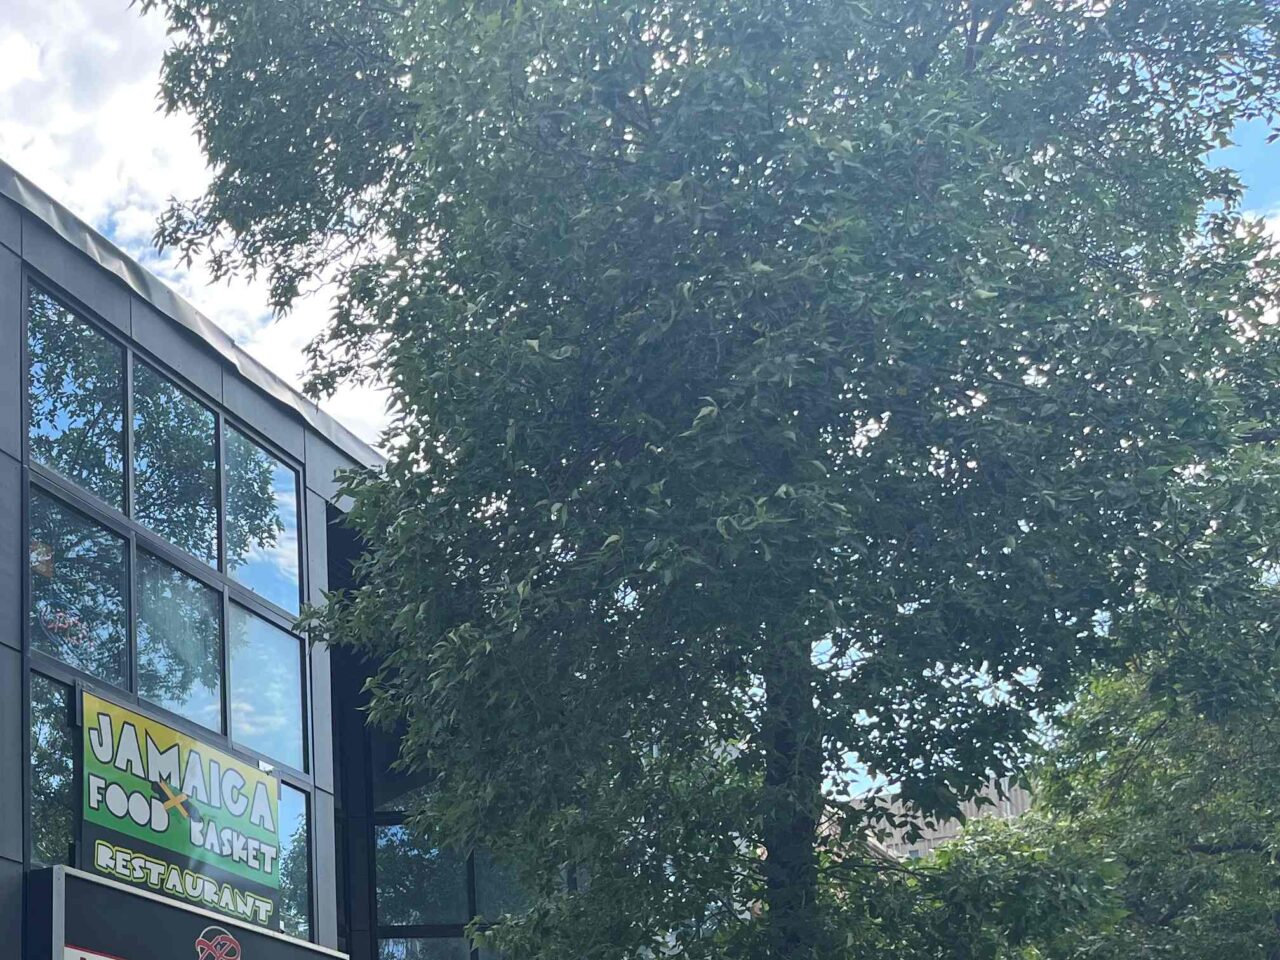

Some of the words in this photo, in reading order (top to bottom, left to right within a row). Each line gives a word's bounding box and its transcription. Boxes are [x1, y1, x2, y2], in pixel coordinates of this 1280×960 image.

[88, 712, 276, 833] JAMAICA
[87, 773, 170, 833] FOOD
[190, 820, 277, 874] BASKET
[94, 839, 273, 924] RESTAURANT
